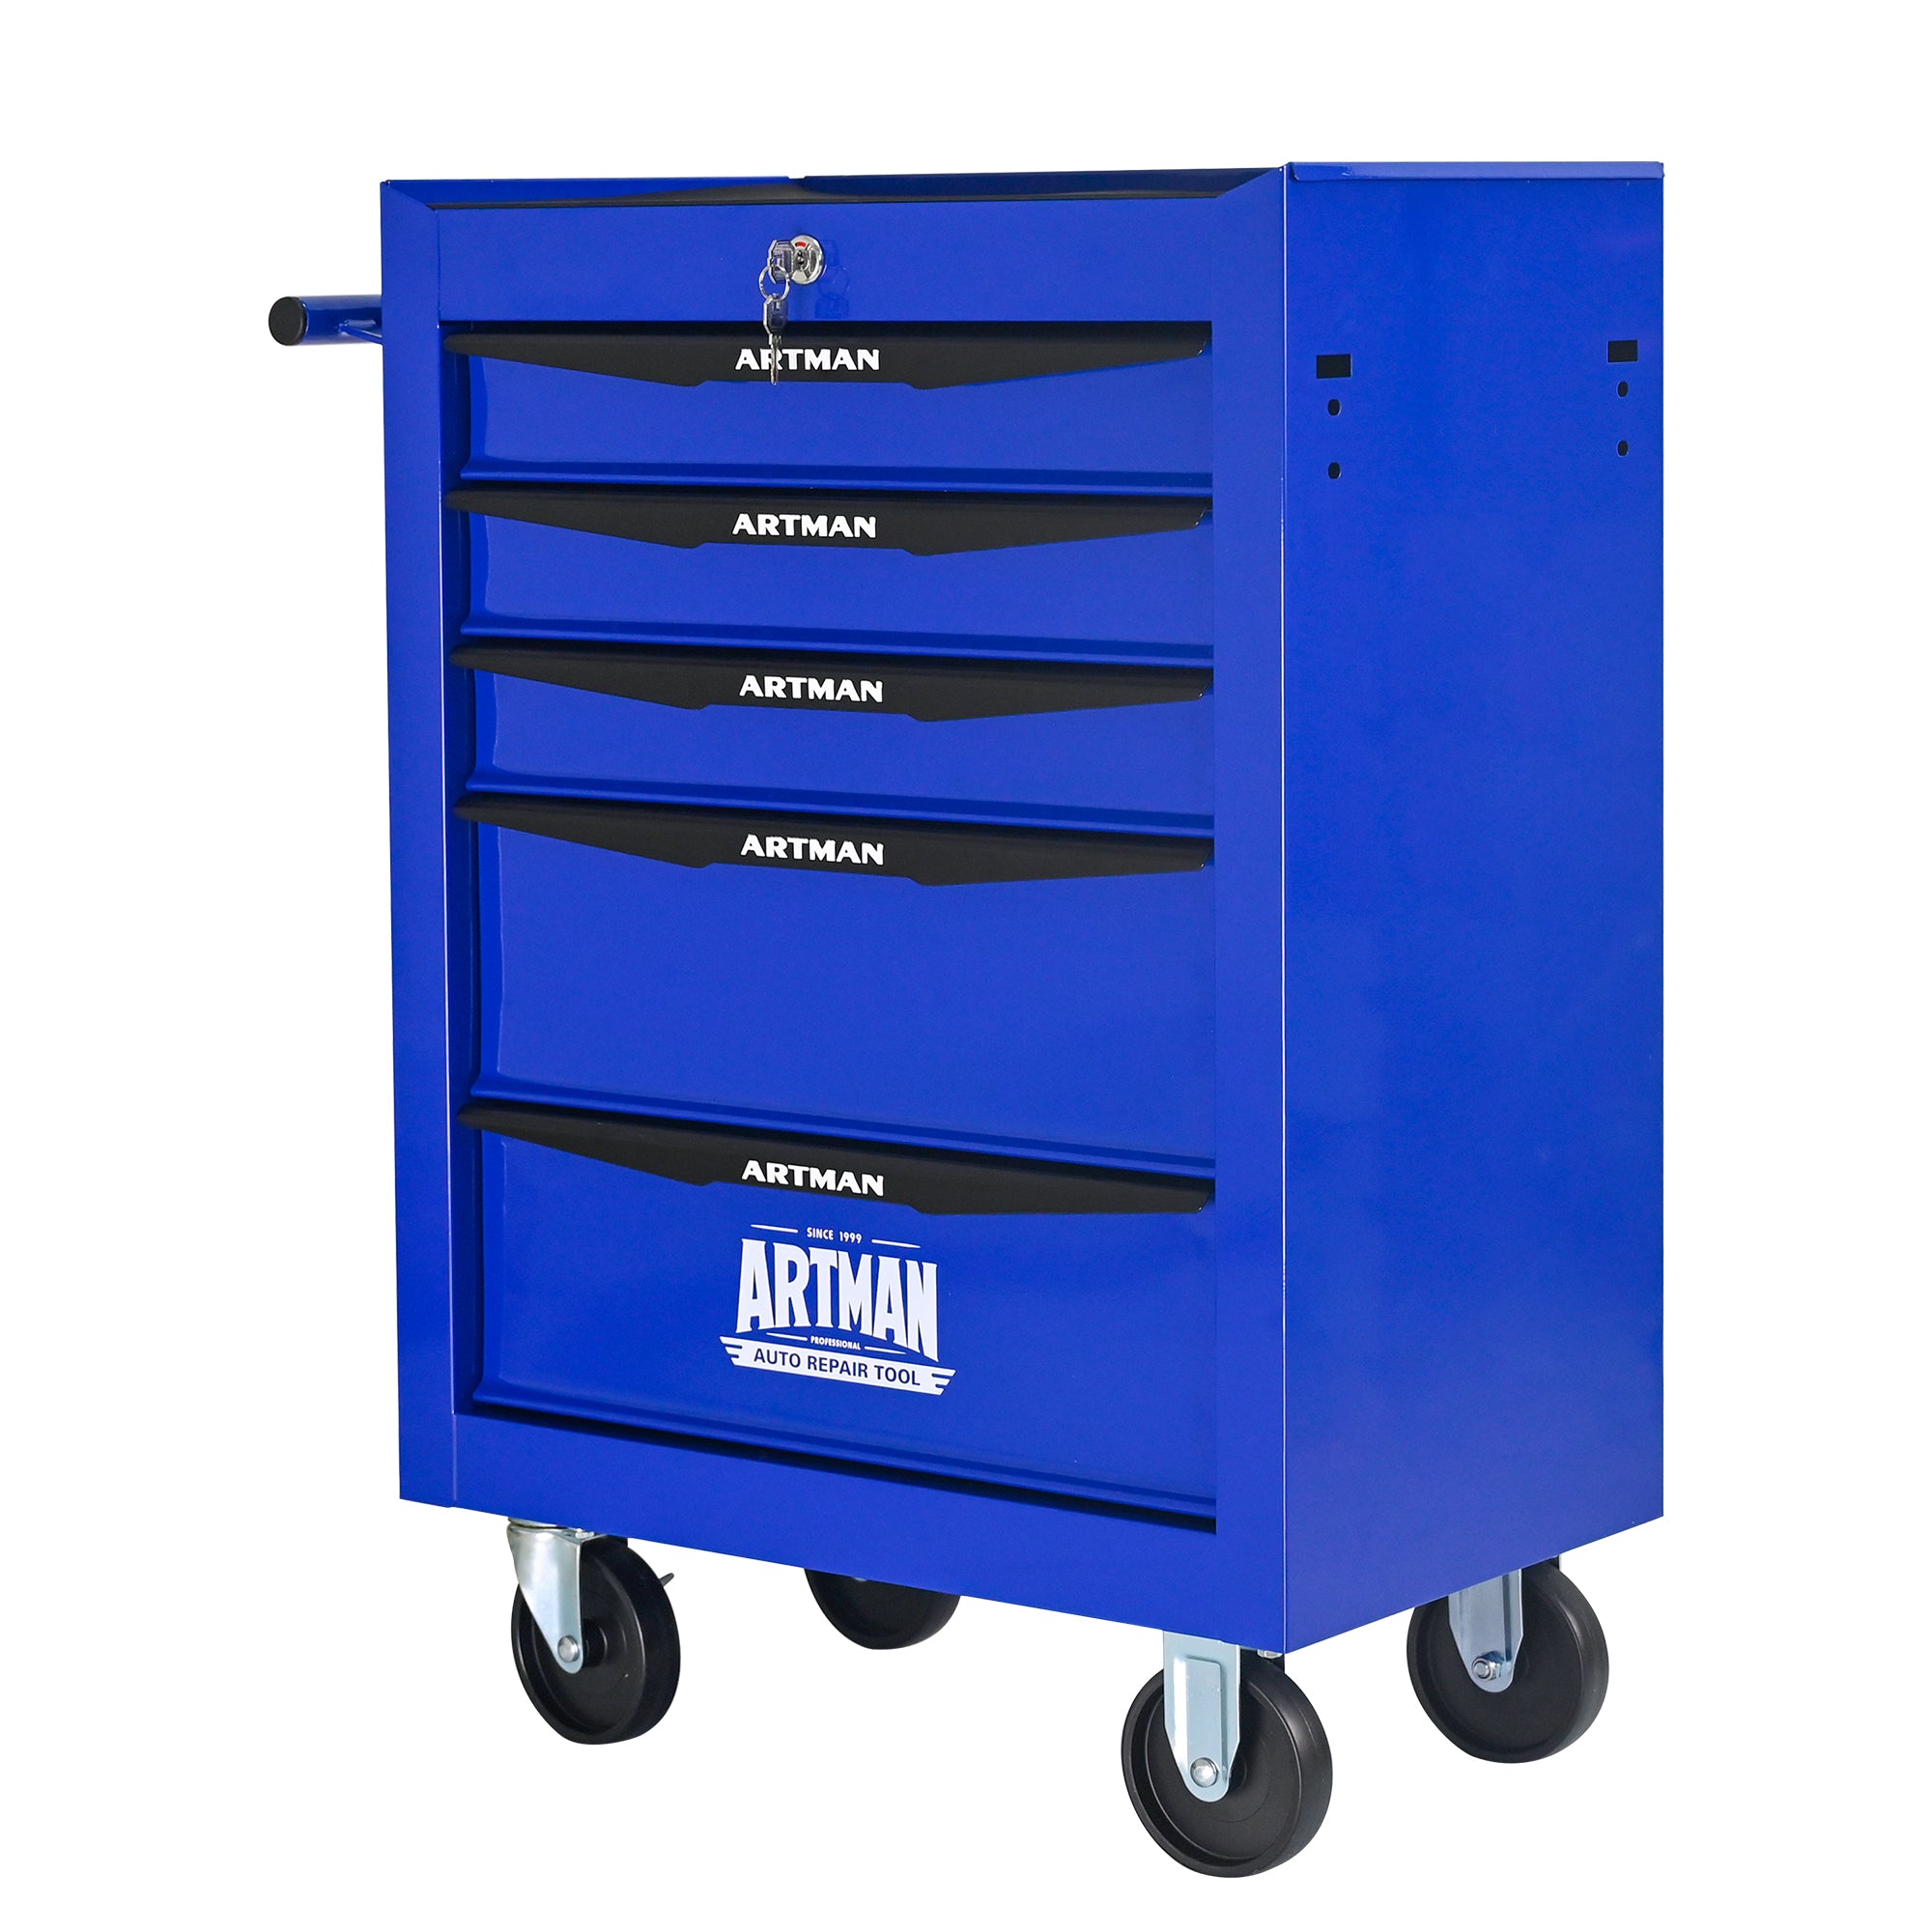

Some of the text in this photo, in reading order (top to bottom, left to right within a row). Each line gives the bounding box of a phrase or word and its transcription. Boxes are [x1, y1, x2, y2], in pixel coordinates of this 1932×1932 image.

[735, 348, 880, 371] ARTMAN
[731, 513, 876, 539] ARTMAN
[739, 674, 883, 703] ARTMAN
[740, 834, 884, 866] ARTMAN
[741, 1159, 884, 1197] ARTMAN
[807, 1227, 863, 1244] SINCE 1999
[735, 1237, 939, 1362] ARTMAN
[810, 1335, 861, 1350] PROFESSIONAL
[753, 1348, 921, 1386] AUTO REPAIR TOOL
